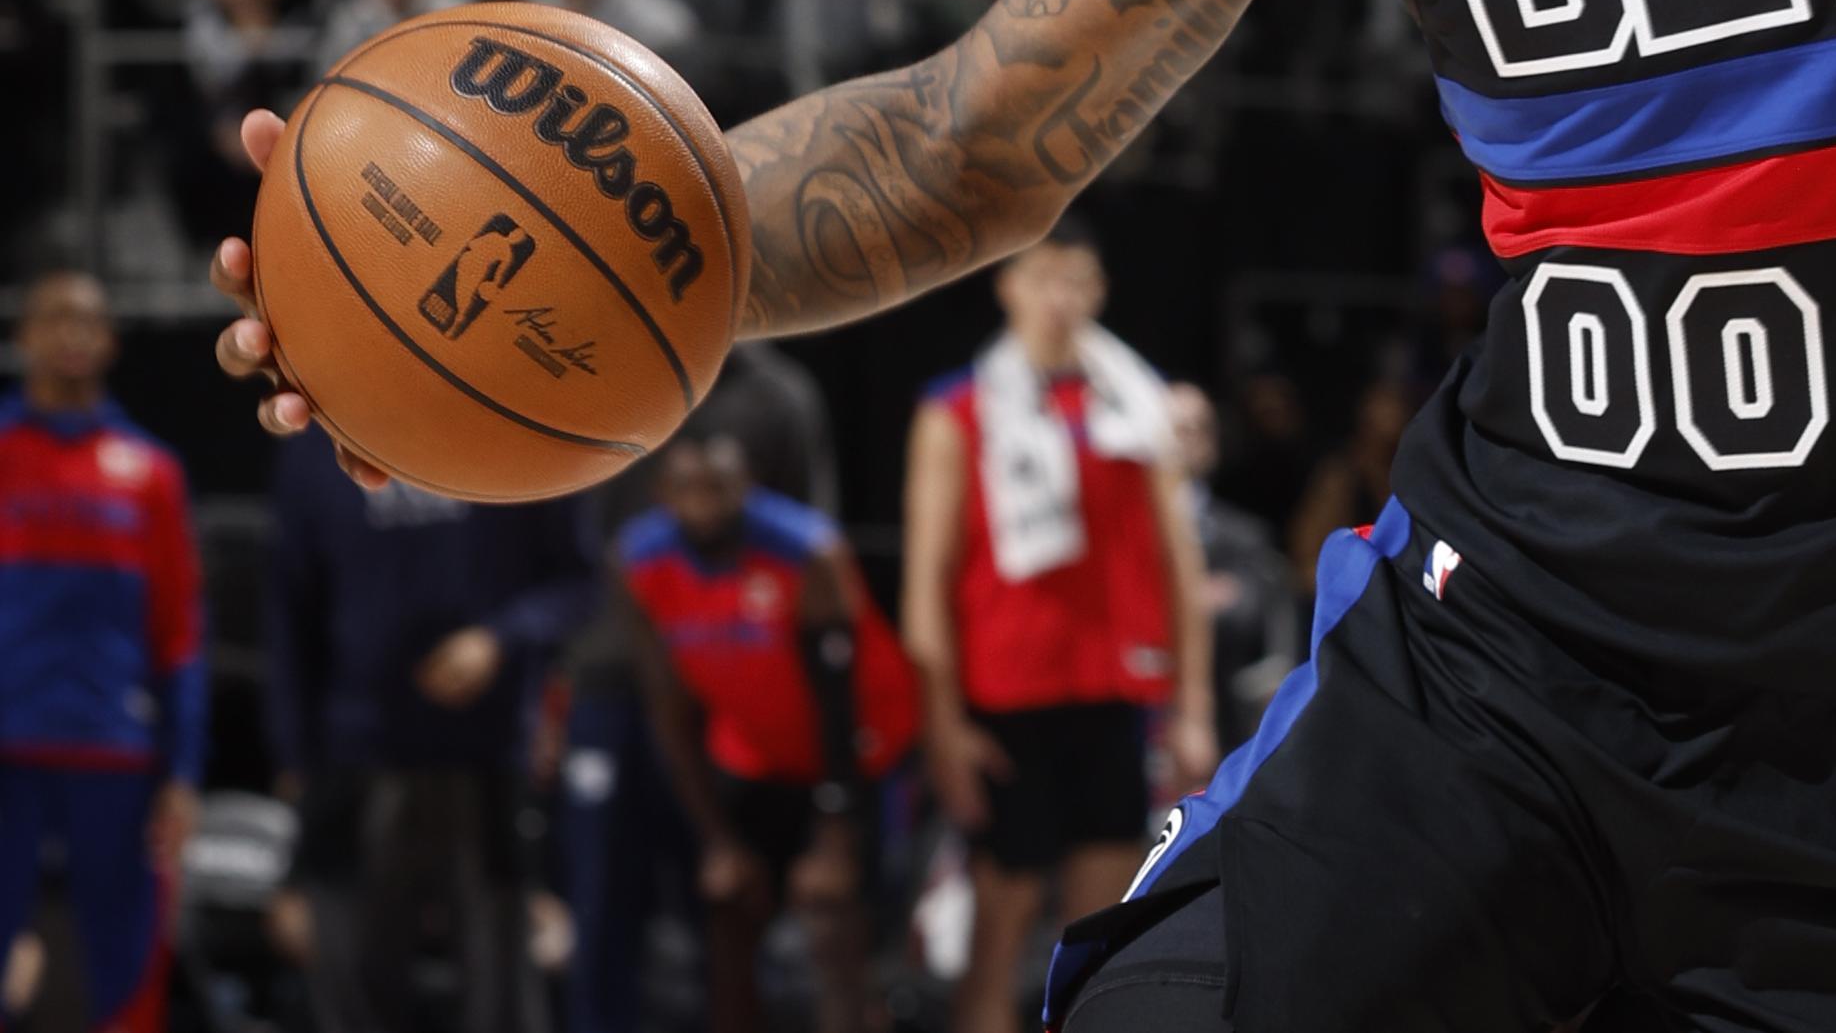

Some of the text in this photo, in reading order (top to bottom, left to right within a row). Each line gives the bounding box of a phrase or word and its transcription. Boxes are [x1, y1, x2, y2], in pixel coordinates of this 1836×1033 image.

[415, 215, 443, 247] BALL
[450, 36, 705, 303] Wilson
[1522, 262, 1830, 471] 00
